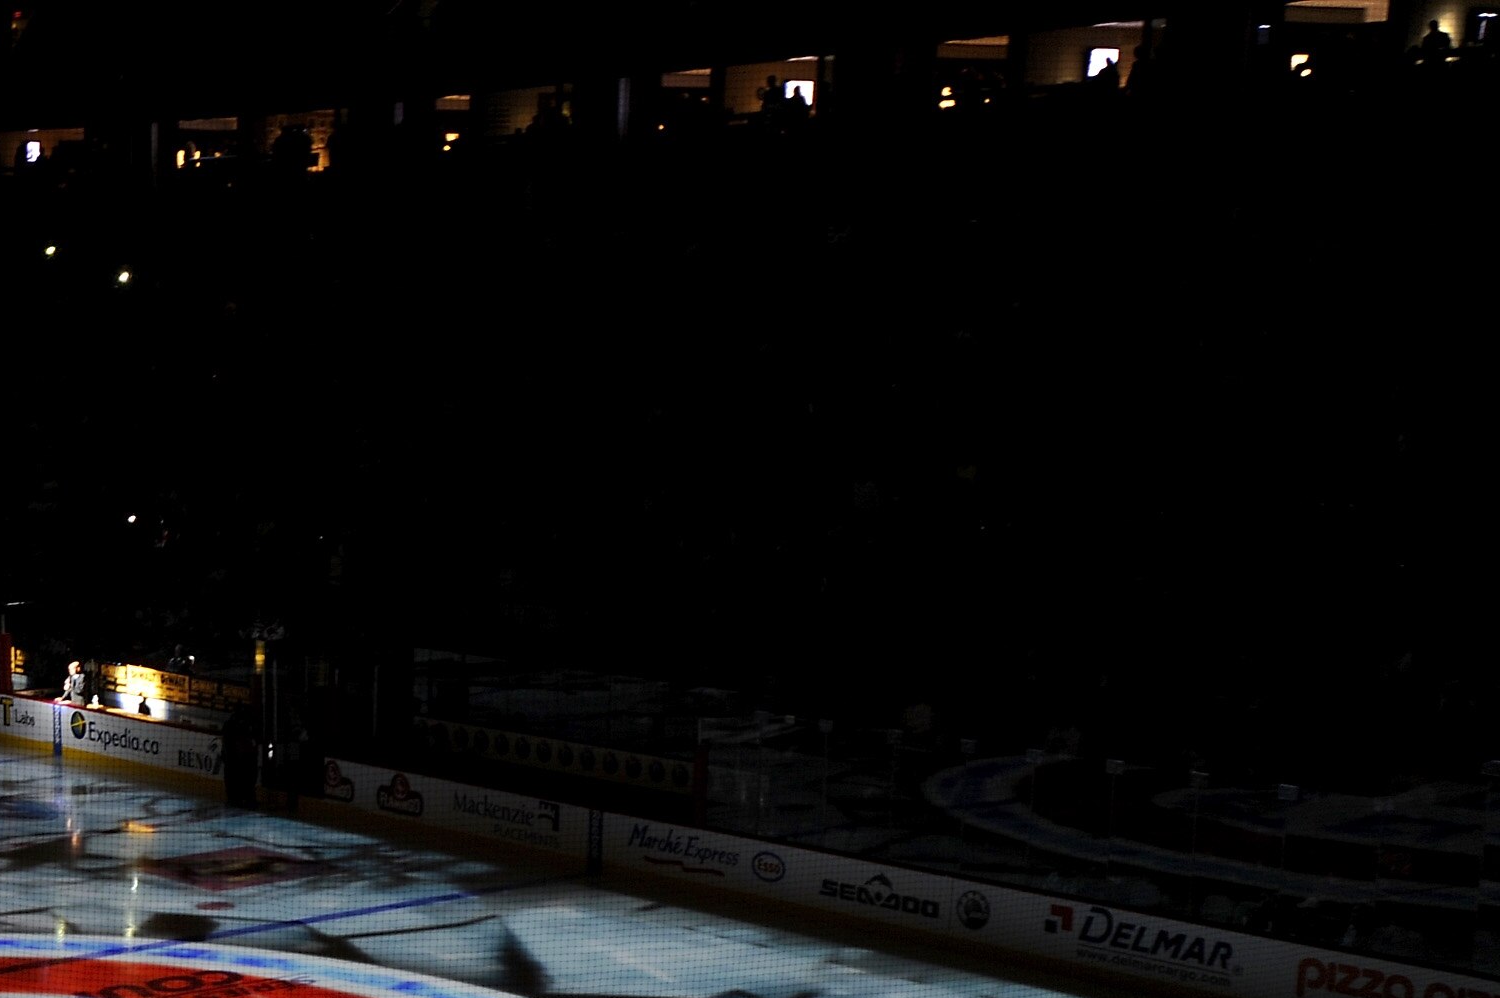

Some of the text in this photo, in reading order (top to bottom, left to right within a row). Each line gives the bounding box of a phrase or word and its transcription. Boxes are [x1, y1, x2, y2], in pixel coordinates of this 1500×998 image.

[87, 719, 161, 756] Expedia.ca
[452, 789, 534, 826] Mackenzie
[628, 823, 741, 867] Marché Express
[756, 857, 782, 876] Esso
[1078, 905, 1234, 970] DELMAR
[1075, 947, 1231, 987] www.delmarcargo.com
